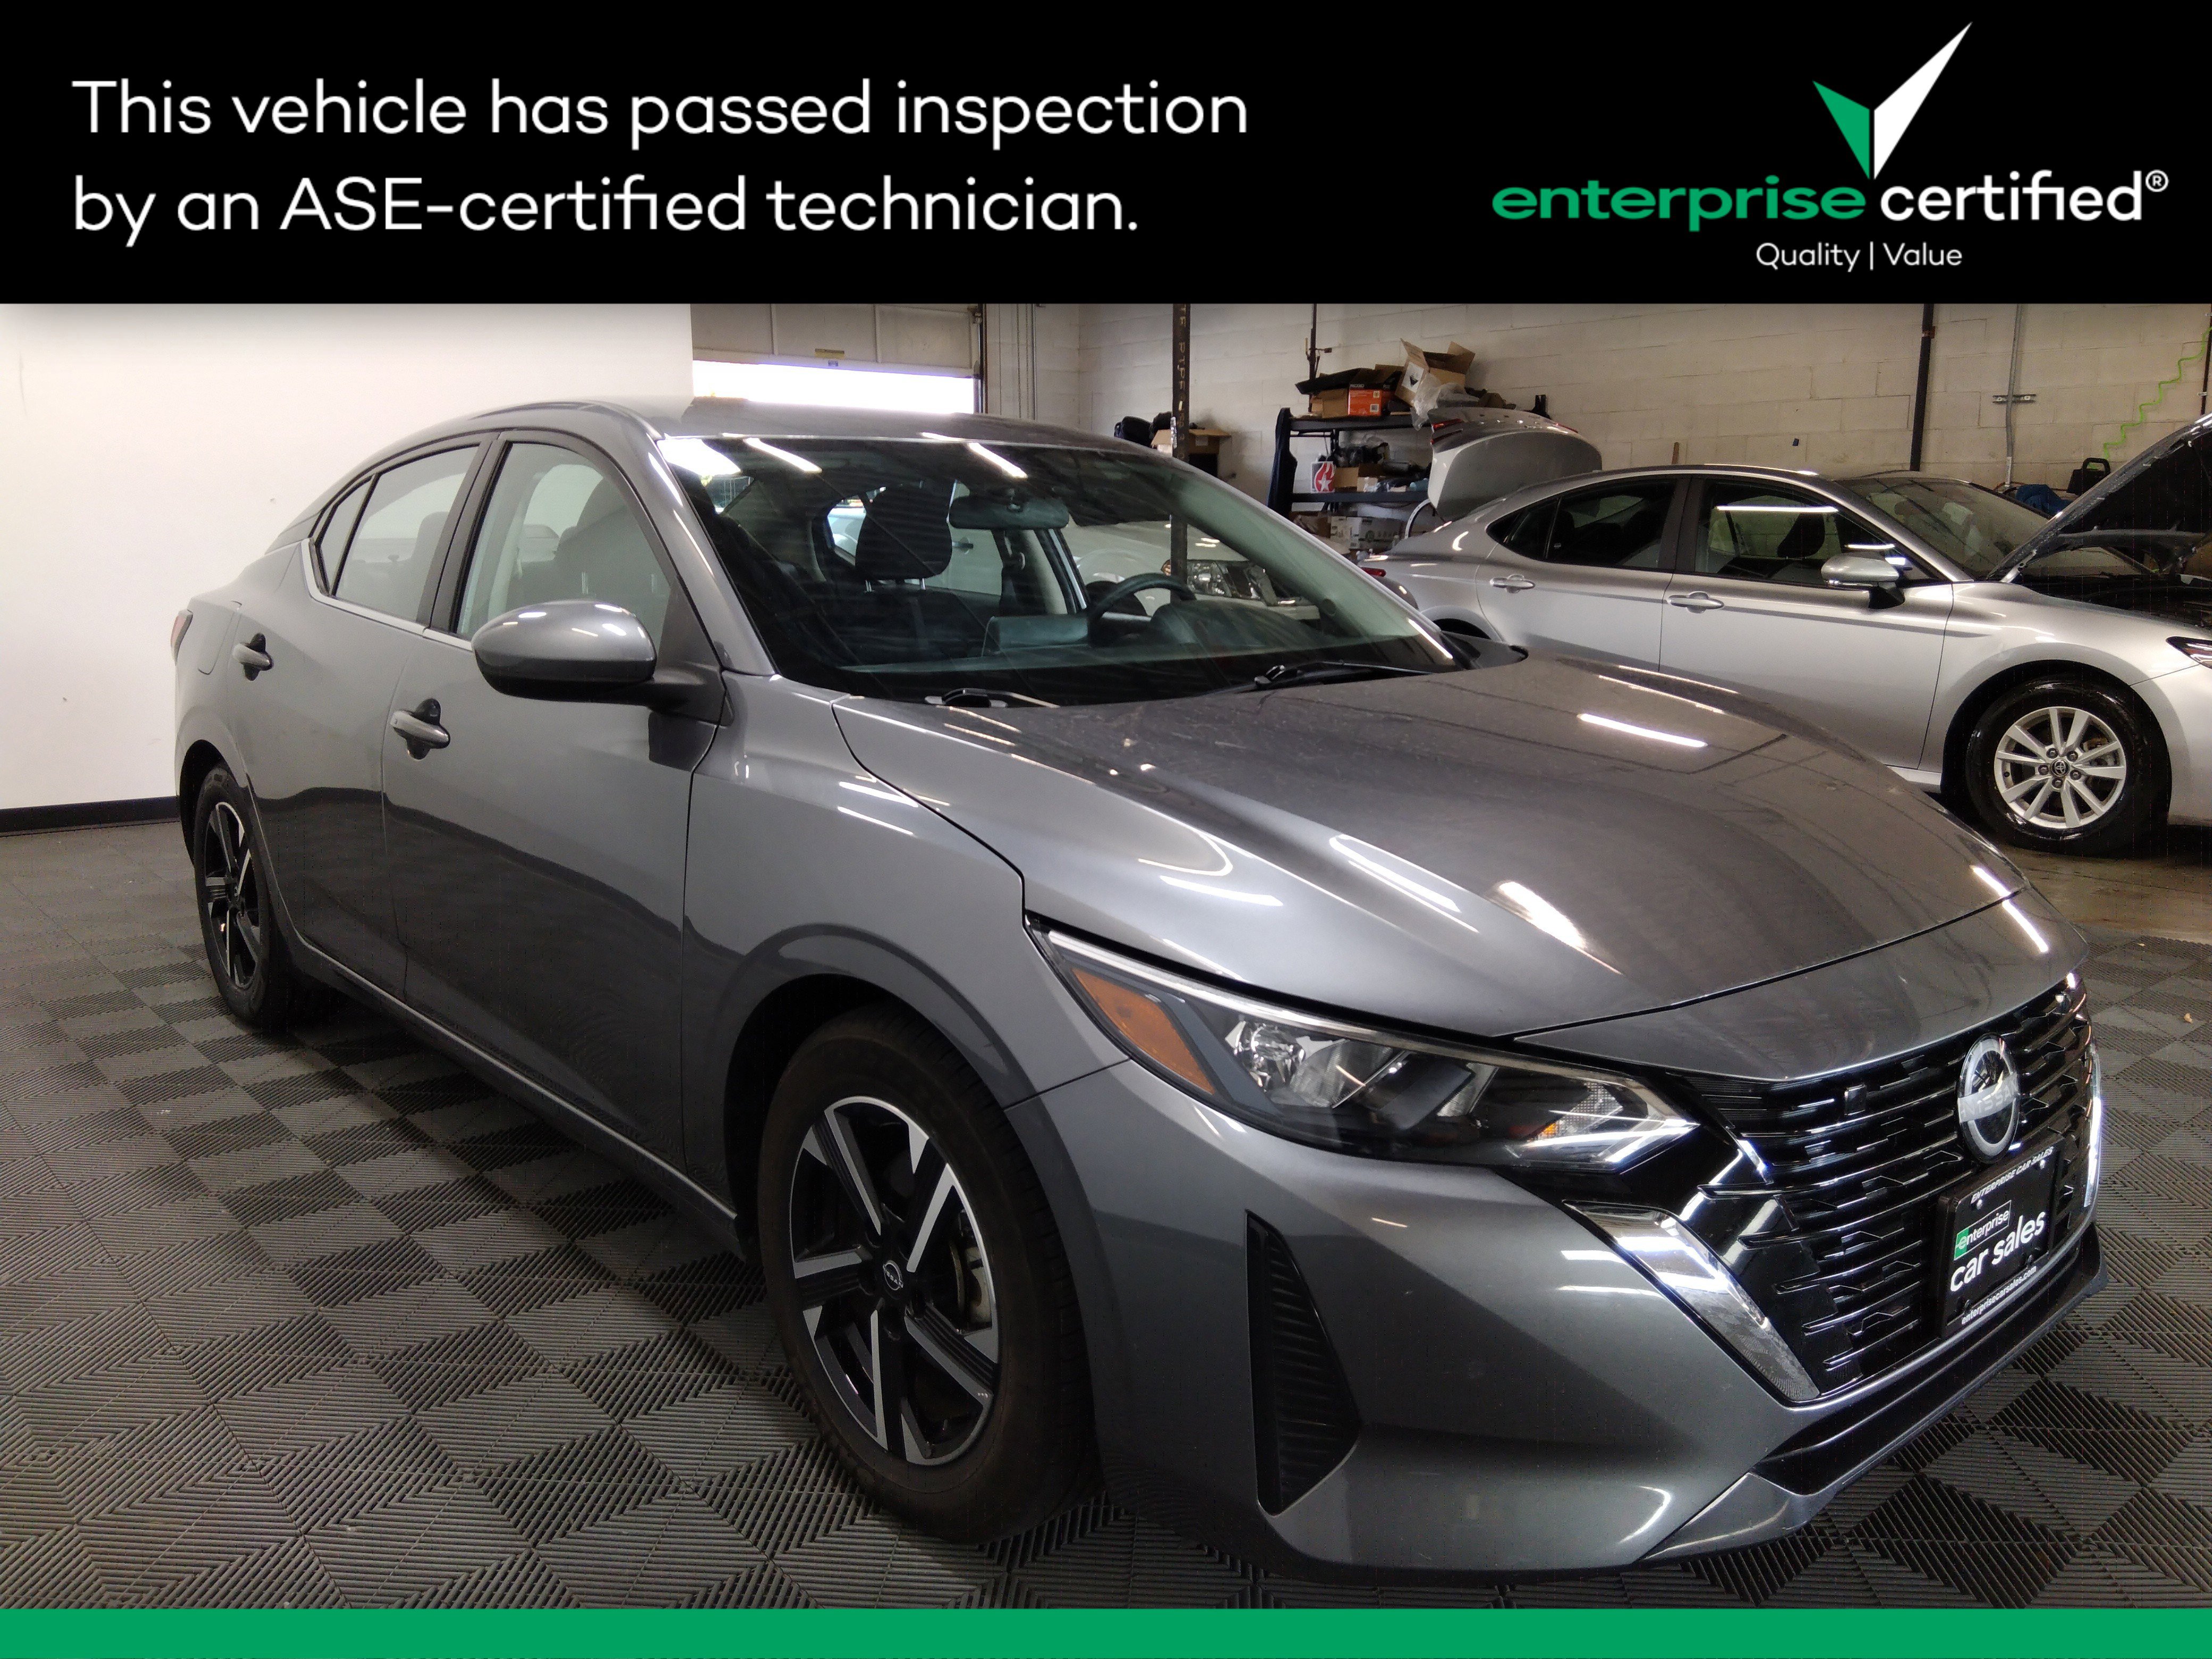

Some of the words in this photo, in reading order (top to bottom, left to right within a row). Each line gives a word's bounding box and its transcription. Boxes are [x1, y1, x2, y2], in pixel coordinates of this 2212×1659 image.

[1971, 1169, 2017, 1204] ENTERPRISE
[2016, 1159, 2031, 1175] CAR
[2031, 1146, 2054, 1165] SALES
[1950, 1249, 1989, 1292] car
[1991, 1211, 2046, 1265] sales
[1956, 1210, 2009, 1250] enterprise
[1962, 1266, 2037, 1325] enterprisecarsales.com
